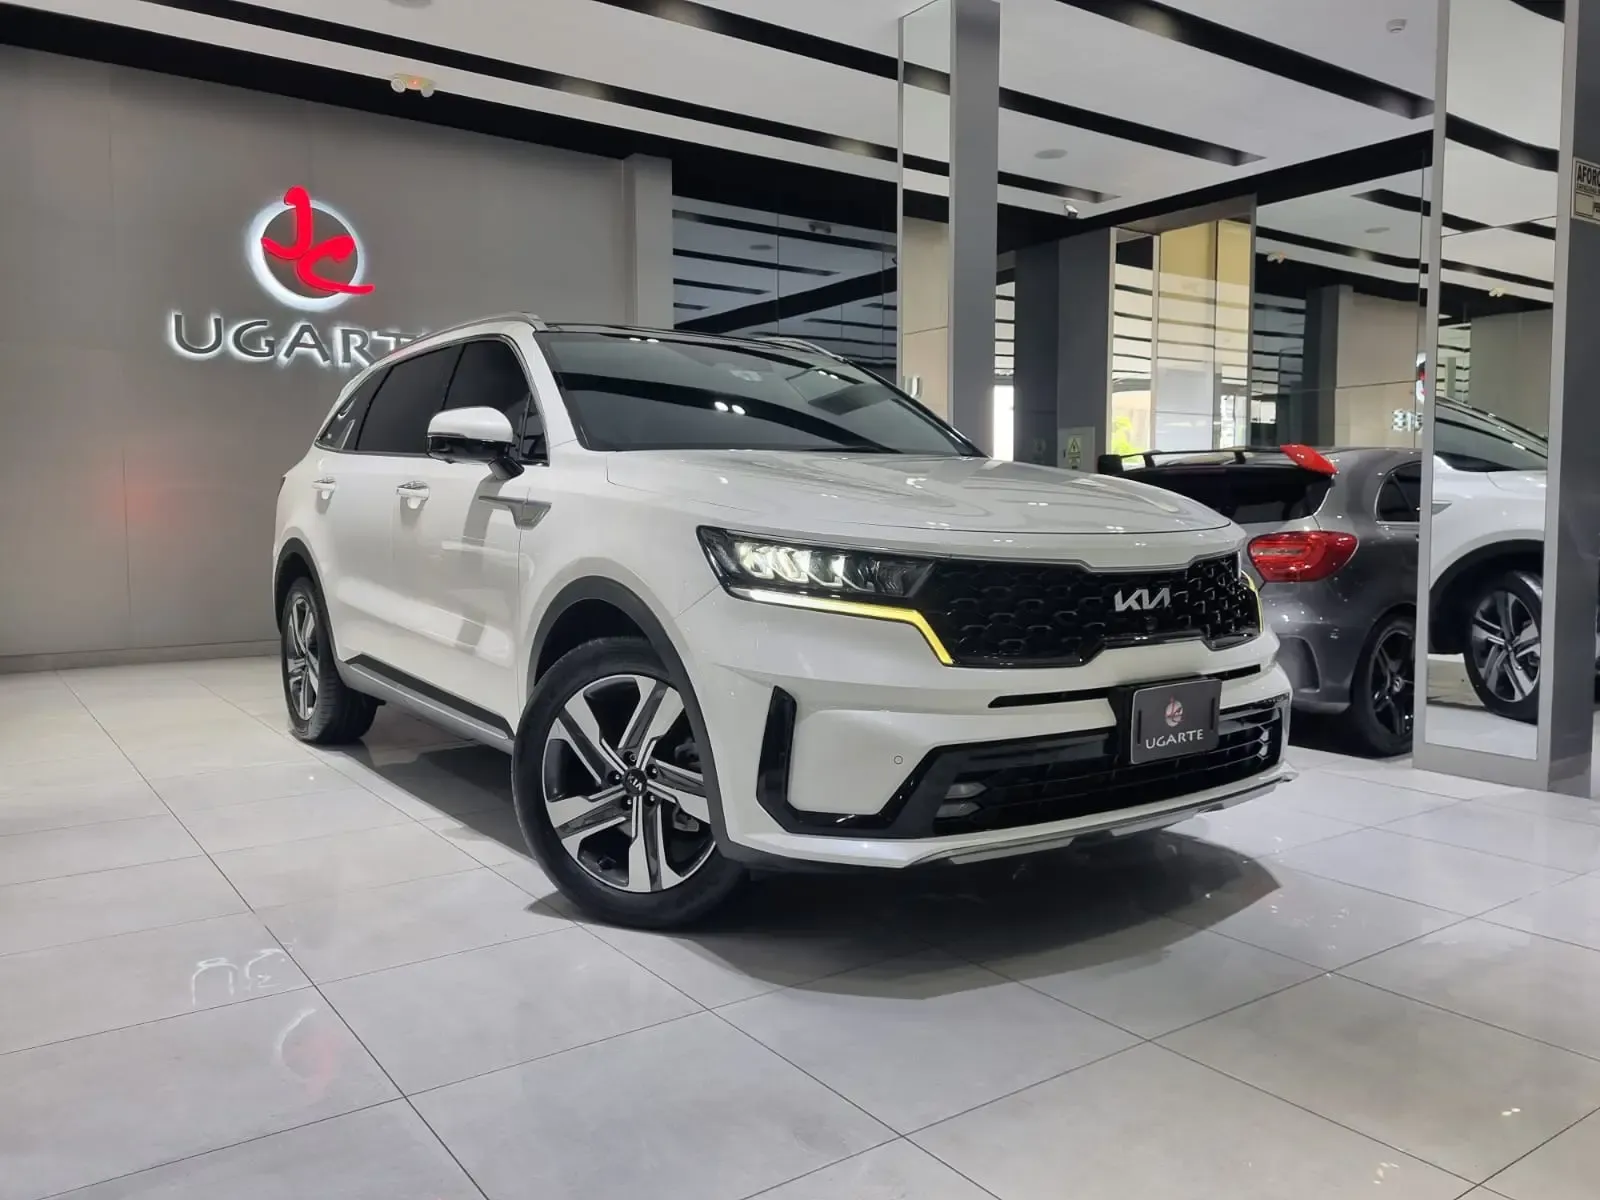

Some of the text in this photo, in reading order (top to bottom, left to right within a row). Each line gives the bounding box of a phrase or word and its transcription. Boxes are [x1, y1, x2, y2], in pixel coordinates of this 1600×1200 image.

[168, 310, 424, 368] UGART
[1114, 587, 1171, 612] KIA
[1145, 728, 1204, 750] UGARTE
